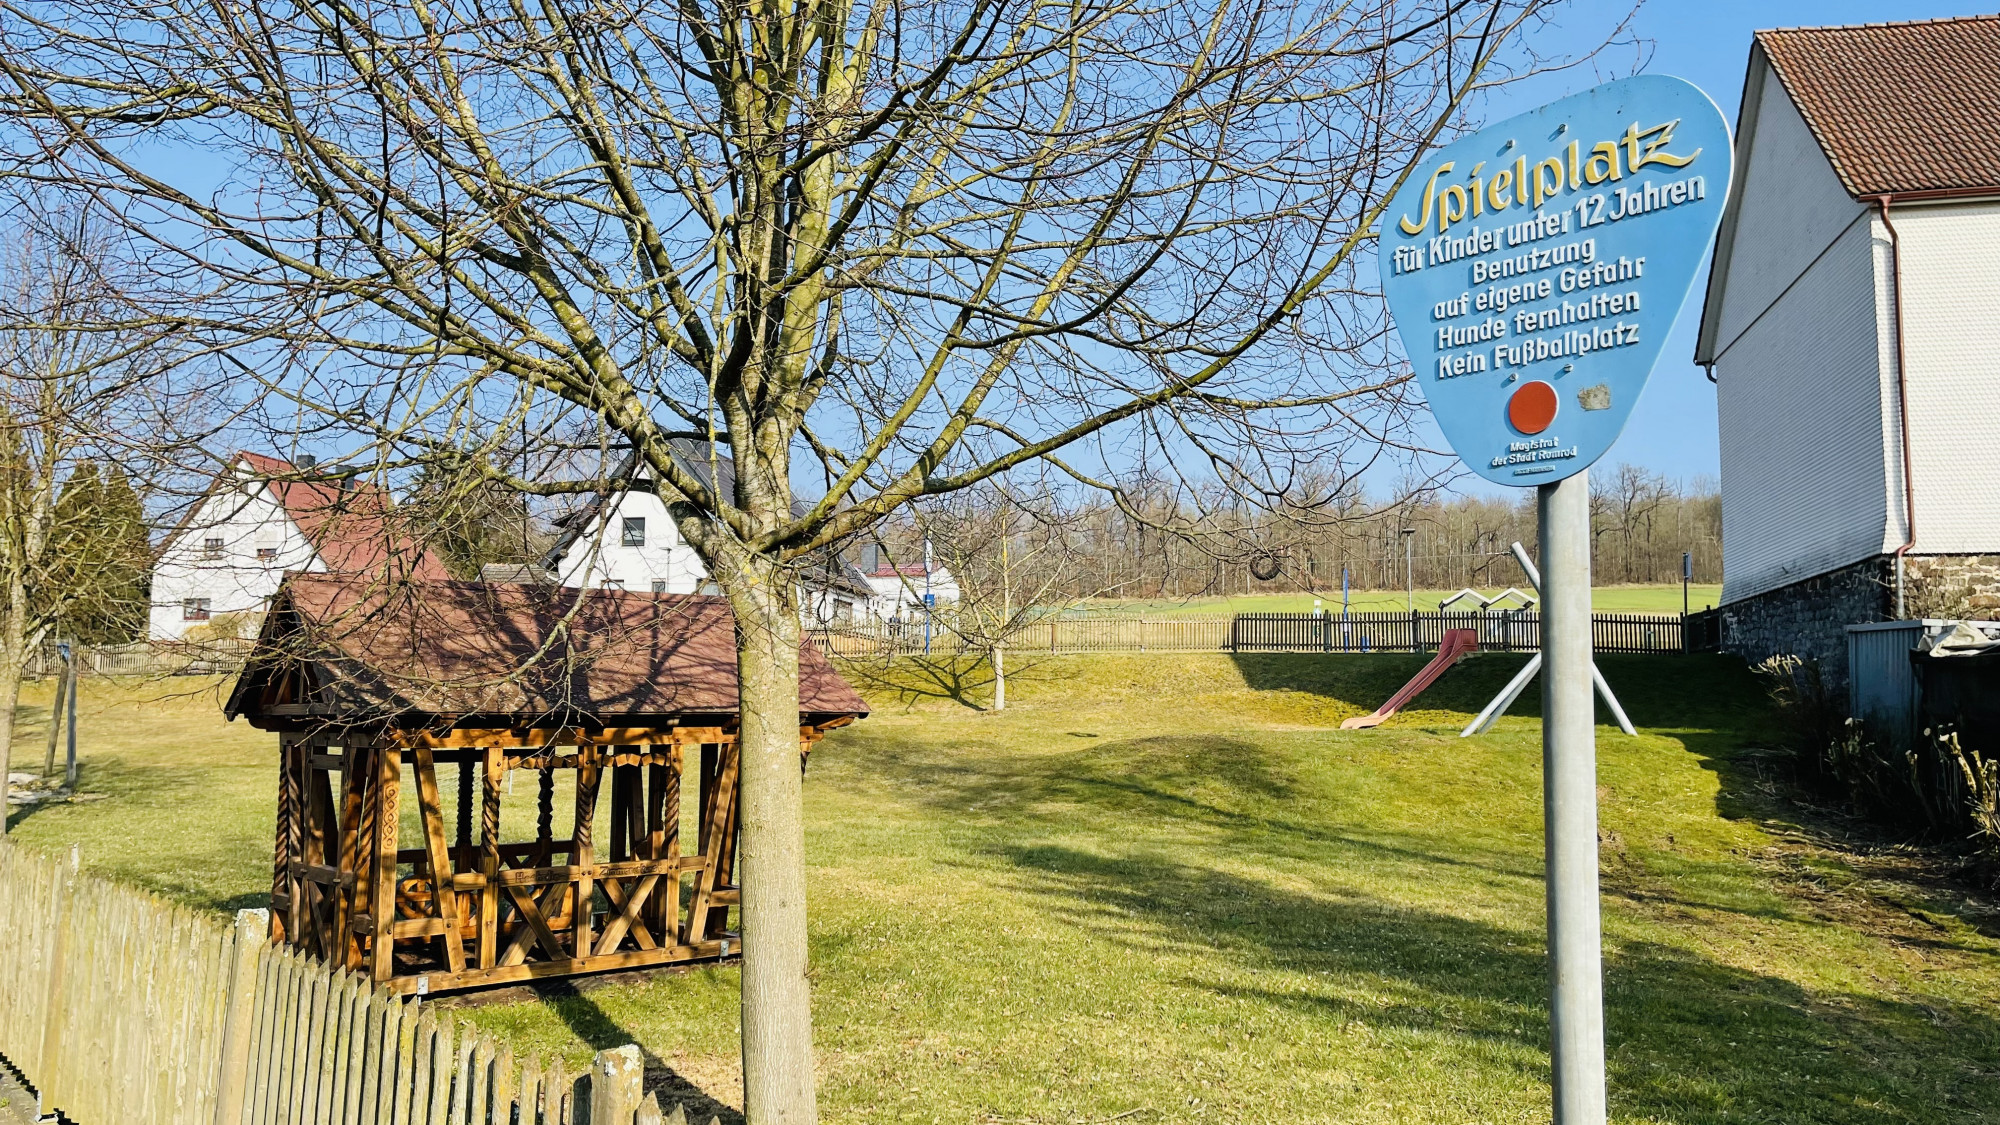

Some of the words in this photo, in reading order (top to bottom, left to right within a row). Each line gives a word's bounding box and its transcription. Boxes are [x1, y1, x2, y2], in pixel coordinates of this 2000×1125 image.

[1399, 118, 1703, 235] Spielplatz
[1393, 244, 1425, 275] für
[1429, 225, 1503, 266] Kinder
[1507, 207, 1573, 246] unter
[1575, 193, 1605, 229] 12
[1608, 175, 1705, 220] Jahren
[1434, 292, 1468, 320] auf
[1475, 278, 1551, 312] eigene
[1560, 257, 1646, 292] Gefahr
[1473, 238, 1595, 285] Benutzung
[1438, 318, 1506, 349] Hunde
[1514, 291, 1640, 334] fernhalten
[1438, 351, 1486, 379] Kein
[1495, 321, 1640, 368] Fußballplatz
[1492, 456, 1508, 466] der
[1509, 451, 1536, 464] Stadt
[1538, 445, 1577, 460] Romrod
[1510, 436, 1559, 452] Magistrat
